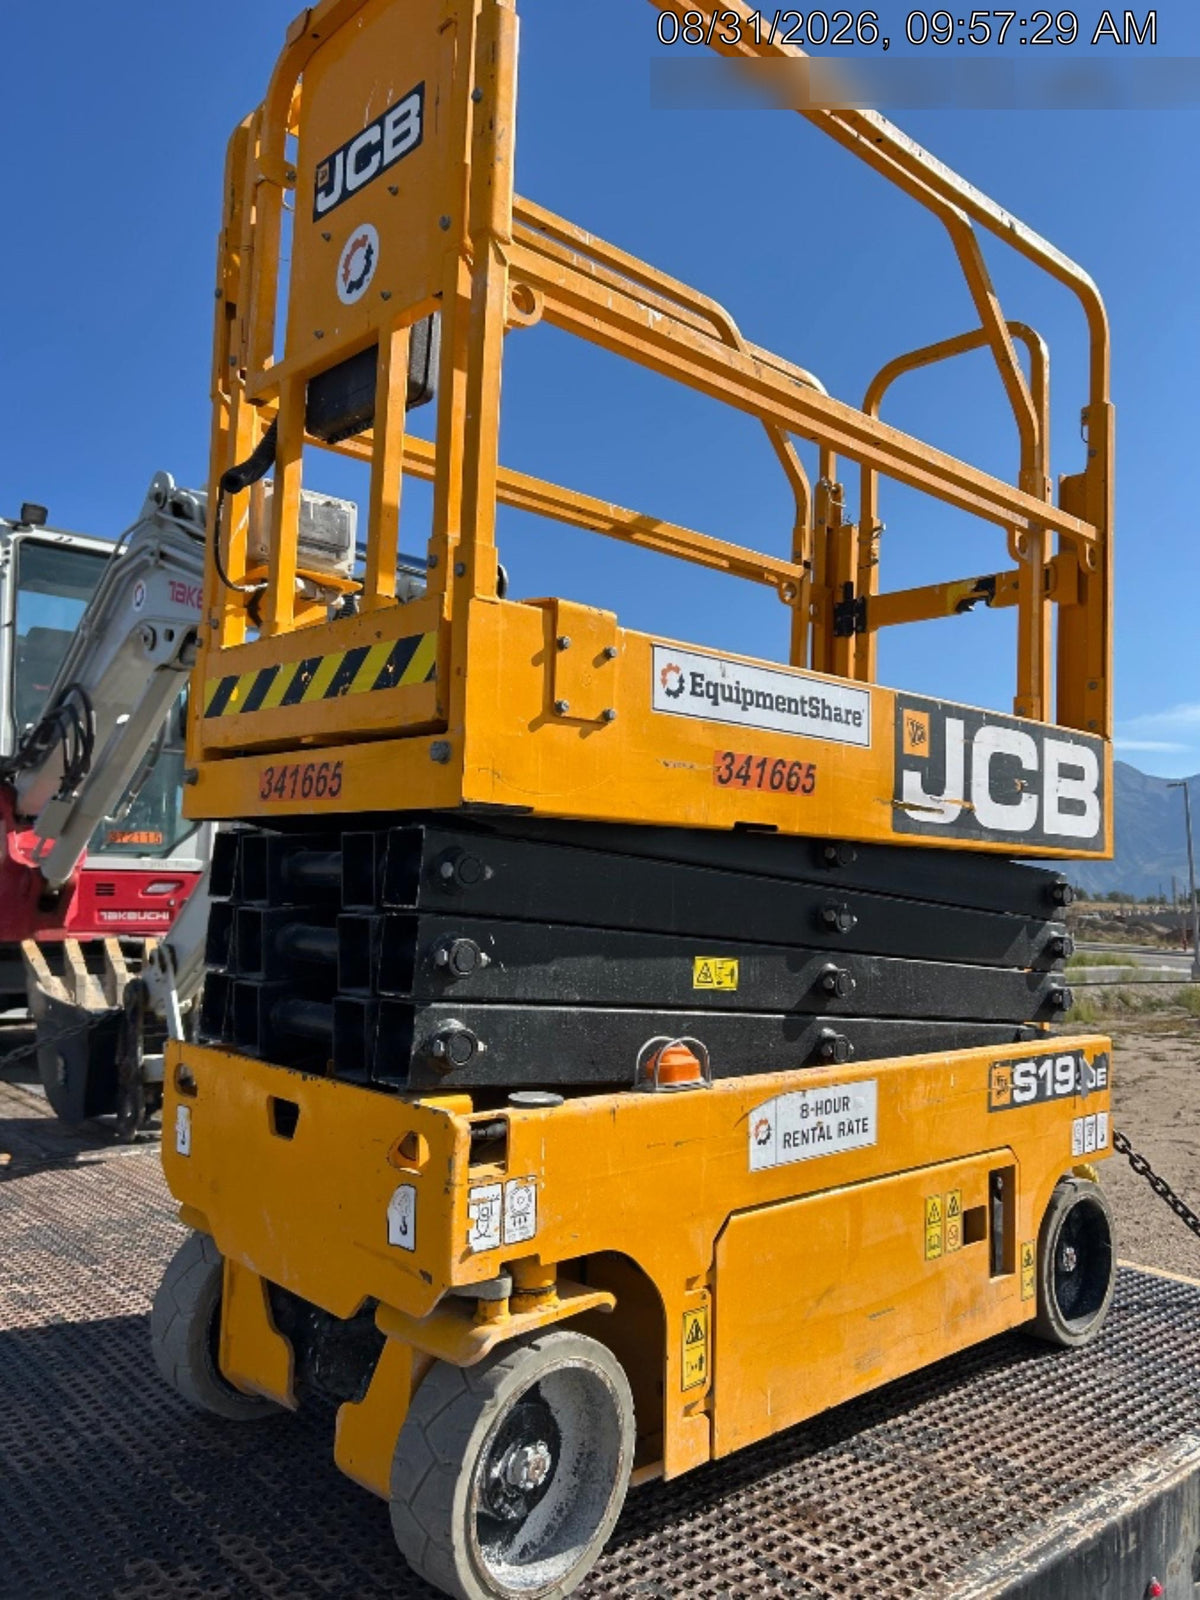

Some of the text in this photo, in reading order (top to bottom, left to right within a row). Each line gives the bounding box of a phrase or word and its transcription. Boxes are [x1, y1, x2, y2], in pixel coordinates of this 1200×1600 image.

[316, 93, 421, 212] JCB
[689, 671, 864, 728] EquipmentShare
[260, 760, 344, 800] 341665
[717, 751, 818, 795] 341665
[902, 717, 1101, 839] JCB
[100, 911, 170, 921] TAKEUCHI
[799, 1096, 851, 1120] 8-HOUR
[782, 1117, 869, 1150] RENTAL RATE
